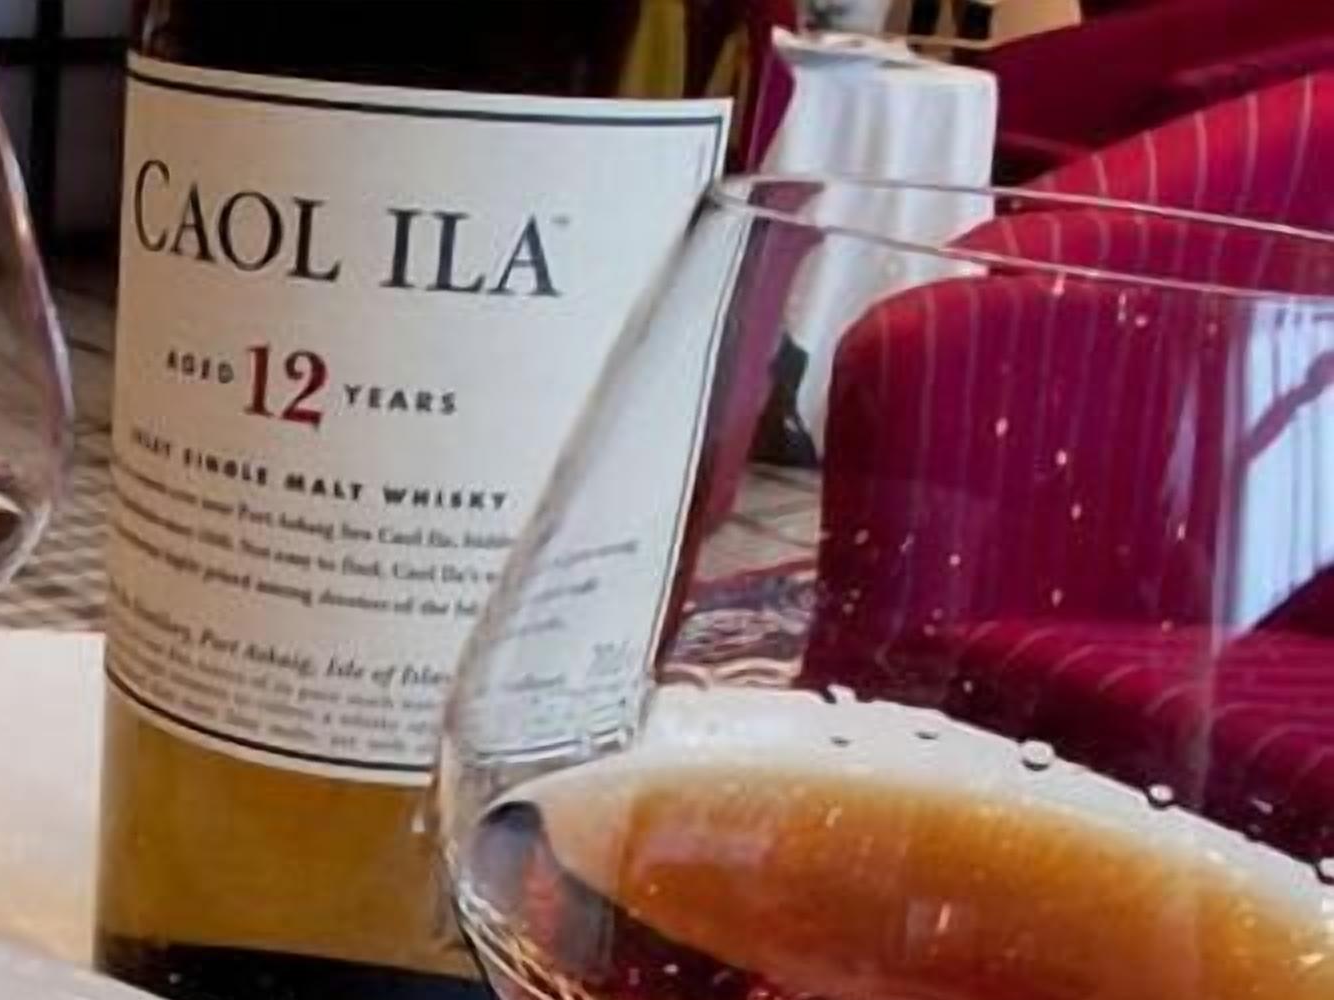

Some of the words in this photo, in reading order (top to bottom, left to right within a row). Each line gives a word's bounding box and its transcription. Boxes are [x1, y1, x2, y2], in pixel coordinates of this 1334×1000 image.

[132, 158, 341, 284] CAOL
[379, 207, 564, 298] ILA
[166, 350, 234, 385] AGED
[242, 343, 331, 430] 12
[343, 382, 459, 416] YEARS
[183, 447, 268, 487] SINGLE
[284, 471, 364, 502] MALT
[381, 486, 508, 511] WHISKY
